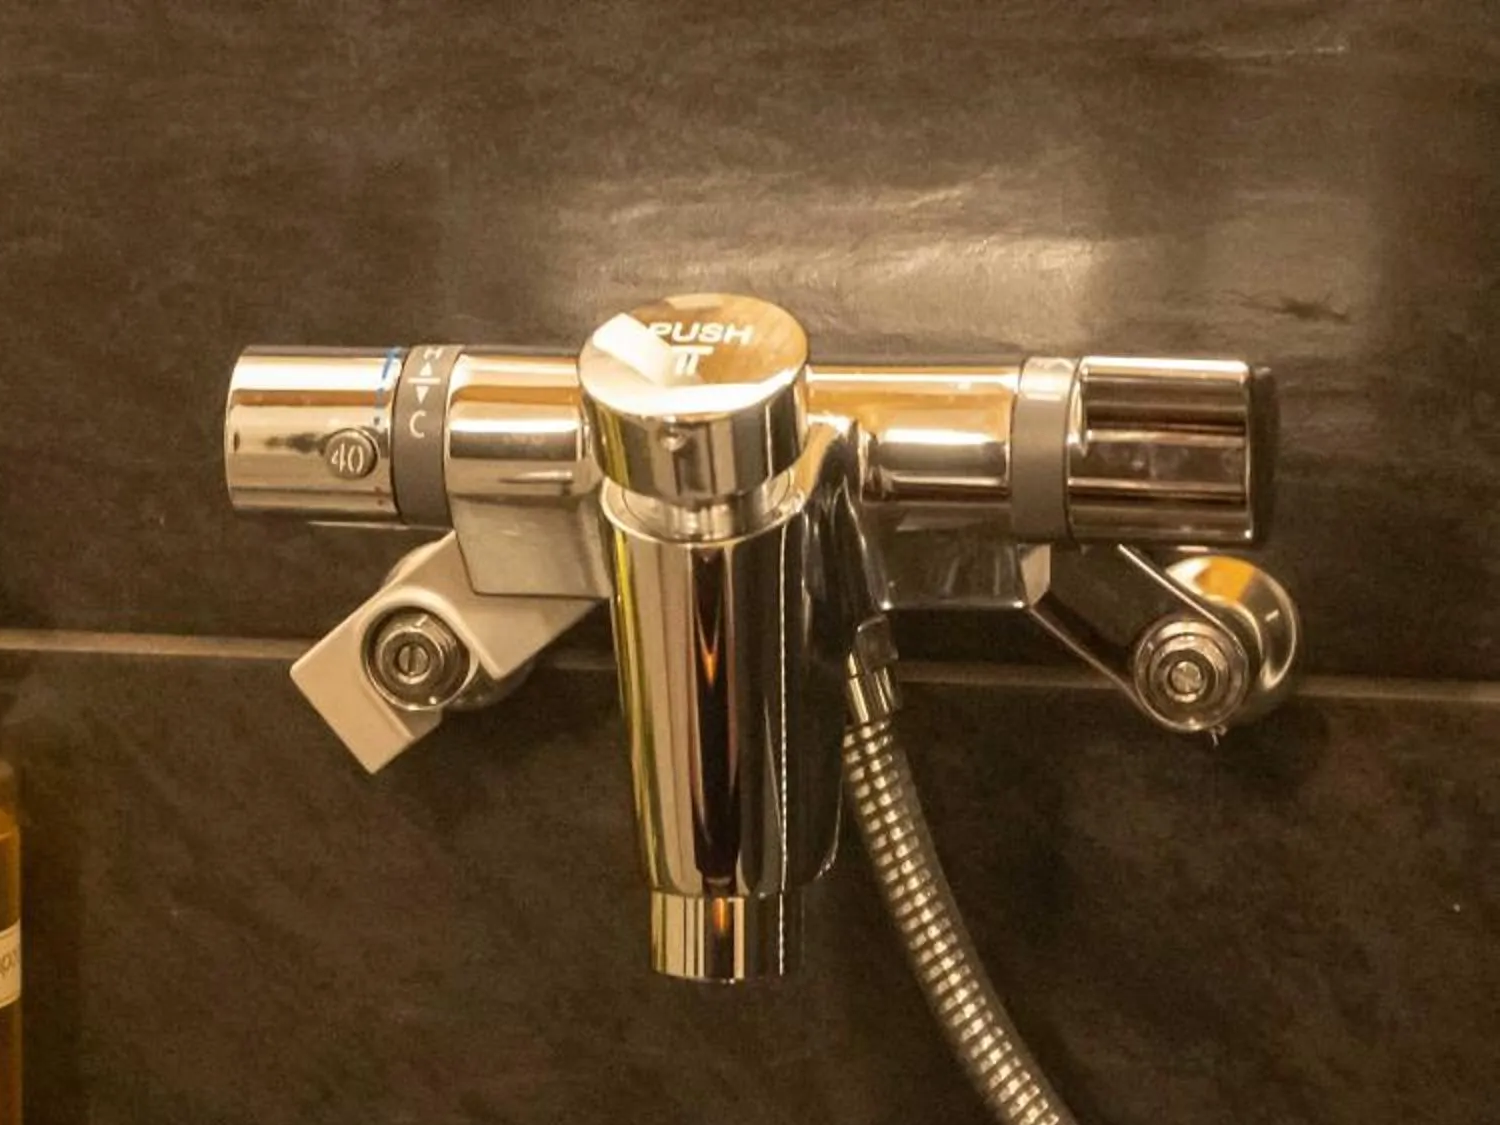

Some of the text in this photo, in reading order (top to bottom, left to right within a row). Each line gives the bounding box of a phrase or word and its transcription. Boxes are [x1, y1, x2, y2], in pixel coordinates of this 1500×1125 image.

[648, 320, 755, 346] PUSH
[408, 409, 427, 439] C
[330, 443, 364, 473] 40
